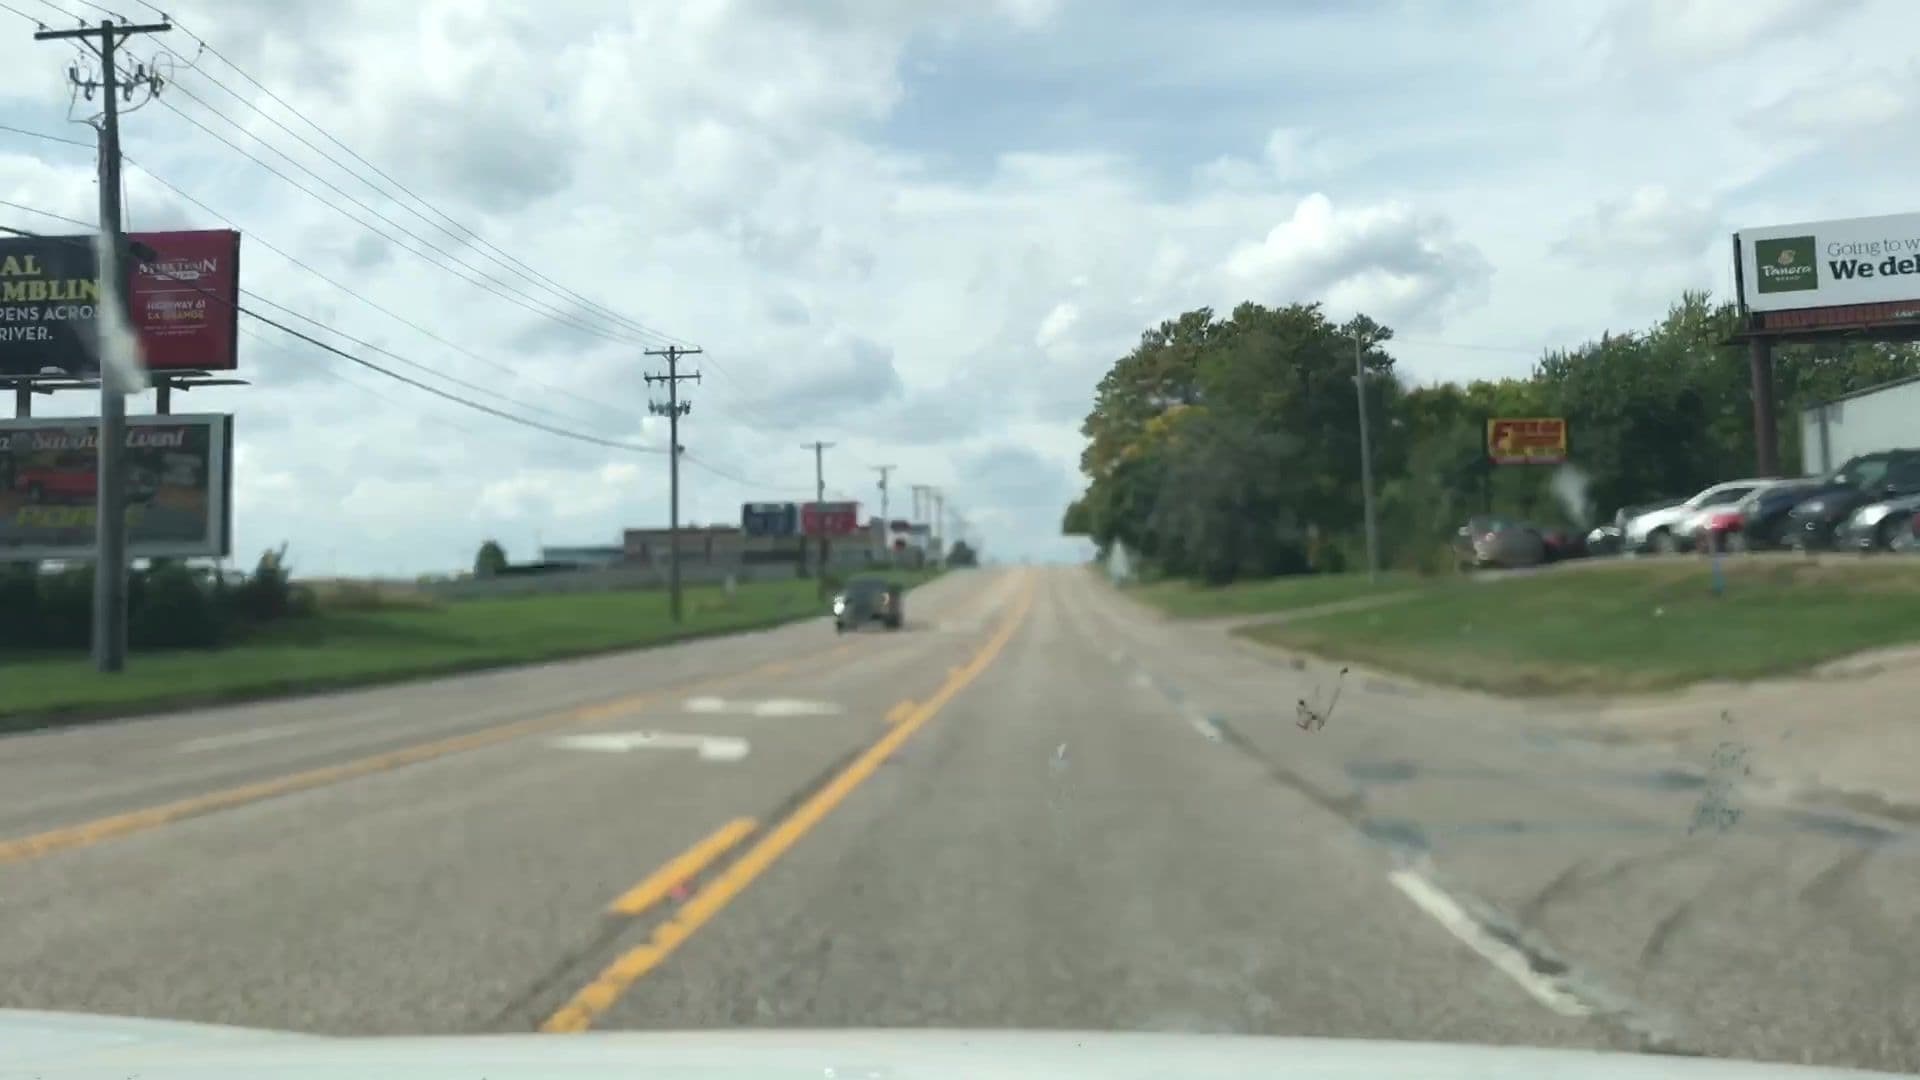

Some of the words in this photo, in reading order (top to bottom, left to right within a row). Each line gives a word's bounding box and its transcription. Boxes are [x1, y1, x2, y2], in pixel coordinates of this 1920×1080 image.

[1828, 241, 1881, 256] Going
[1884, 238, 1901, 252] to
[1829, 259, 1874, 280] We
